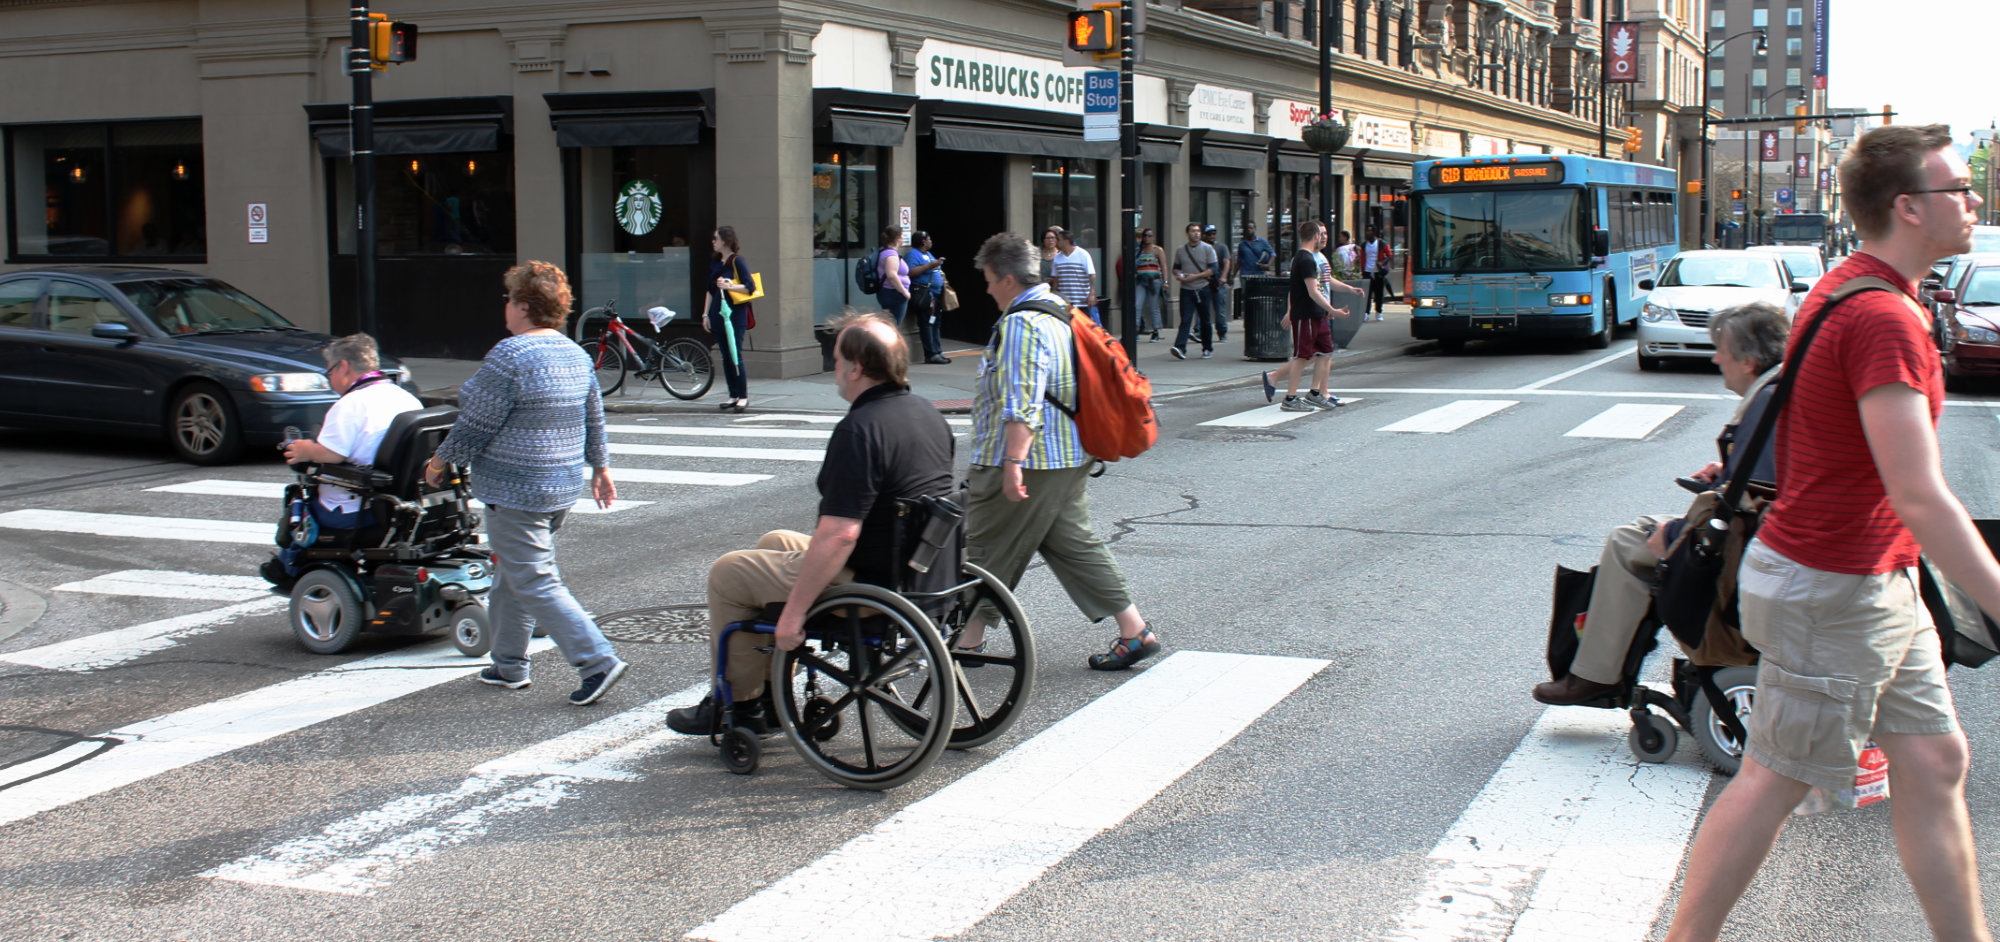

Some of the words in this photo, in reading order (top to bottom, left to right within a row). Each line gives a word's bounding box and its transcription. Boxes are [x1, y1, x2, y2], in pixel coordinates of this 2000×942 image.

[930, 54, 1040, 99] STARBUCKS
[1045, 73, 1083, 105] COFF
[1089, 75, 1114, 90] Bus
[1086, 92, 1117, 109] Stop
[1358, 121, 1379, 146] ACE
[1441, 167, 1460, 183] 61B
